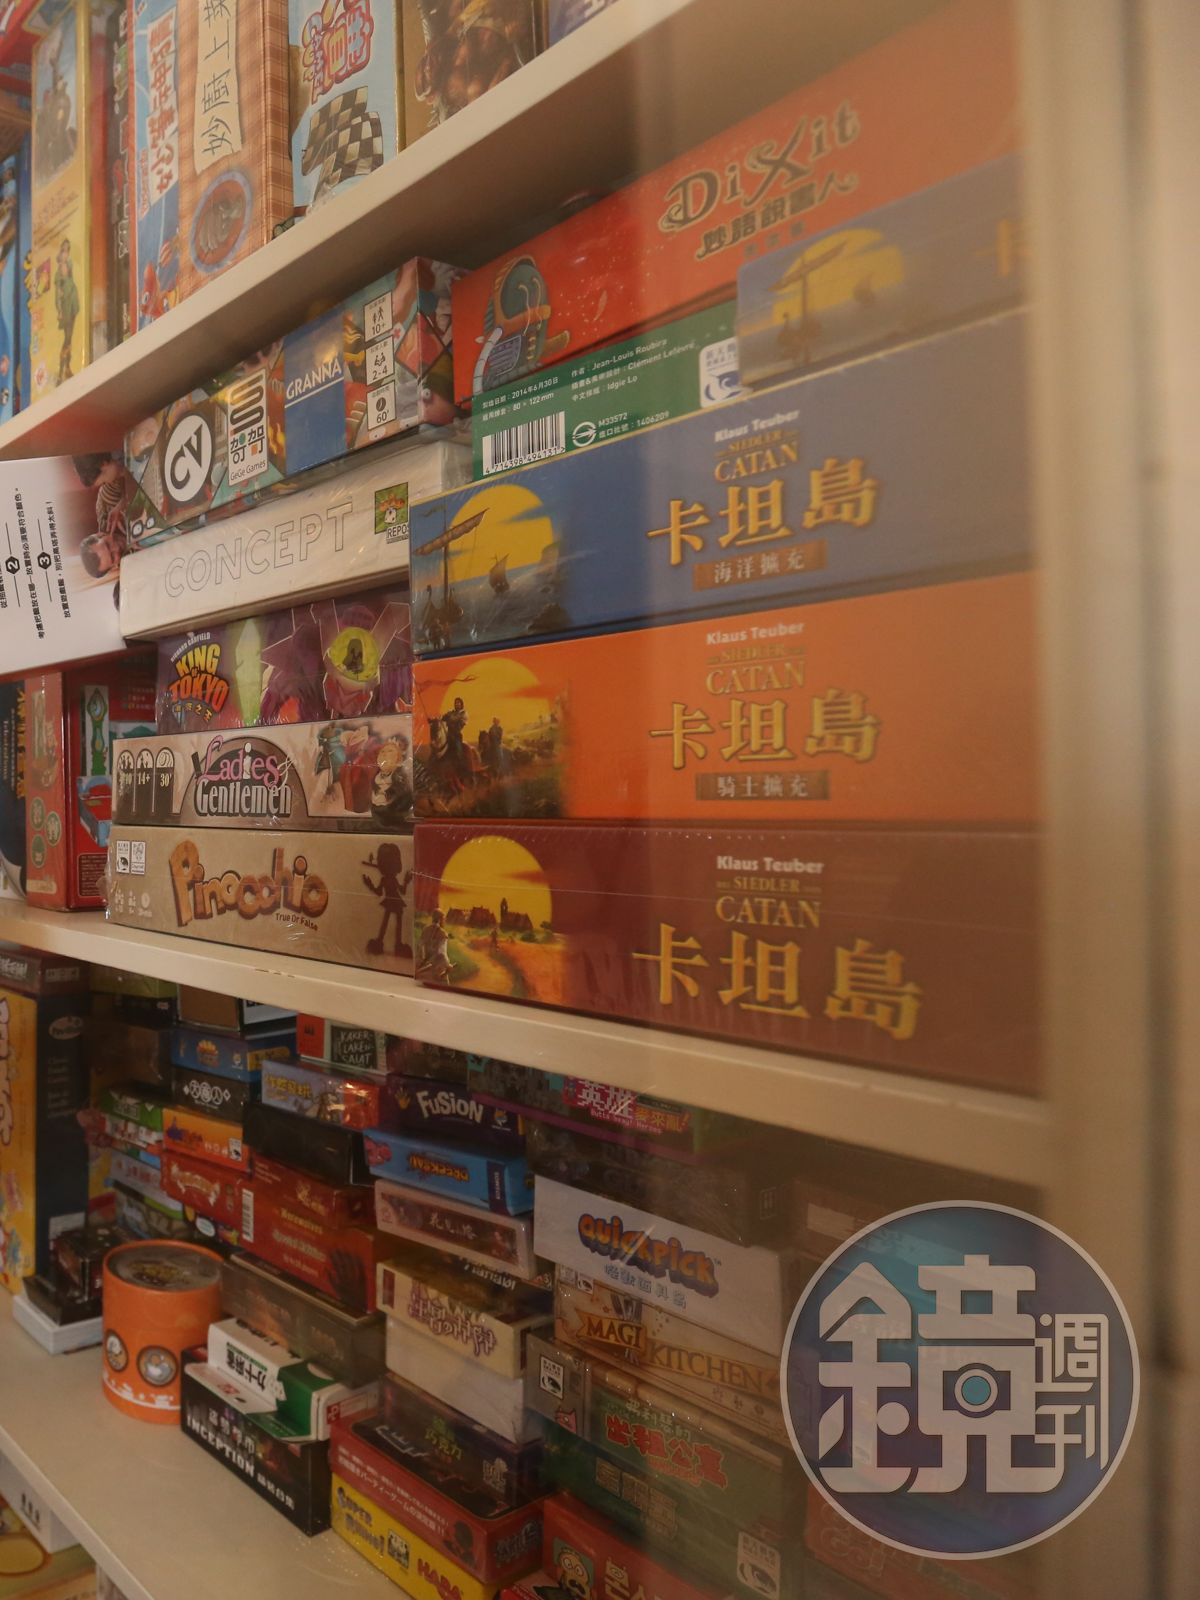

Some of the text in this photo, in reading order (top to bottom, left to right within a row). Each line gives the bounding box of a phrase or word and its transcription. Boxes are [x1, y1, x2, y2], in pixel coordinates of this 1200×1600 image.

[286, 357, 342, 400] GRANNA
[372, 366, 389, 381] 2-4
[714, 409, 800, 443] Klaus Teuber
[714, 441, 799, 483] CATAN
[647, 456, 878, 566] 卡坦島
[165, 502, 353, 598] CONCEPT
[706, 620, 804, 646] Klaus Teuber
[175, 643, 221, 677] KING
[705, 661, 805, 696] CATAN
[168, 674, 229, 712] TOKYO
[649, 688, 880, 770] 卡坦島
[200, 735, 280, 791] Ladies
[195, 779, 292, 817] Gentlemen
[170, 839, 329, 928] Pinocchio
[716, 855, 823, 876] Klaus Teuber
[715, 895, 821, 930] CATAN
[631, 922, 923, 1041] 卡坦島
[343, 1052, 372, 1066] SALAT
[586, 1313, 764, 1395] MAGI KITCHEN
[186, 1415, 256, 1479] INCEPTION
[417, 1558, 464, 1600] HABA
